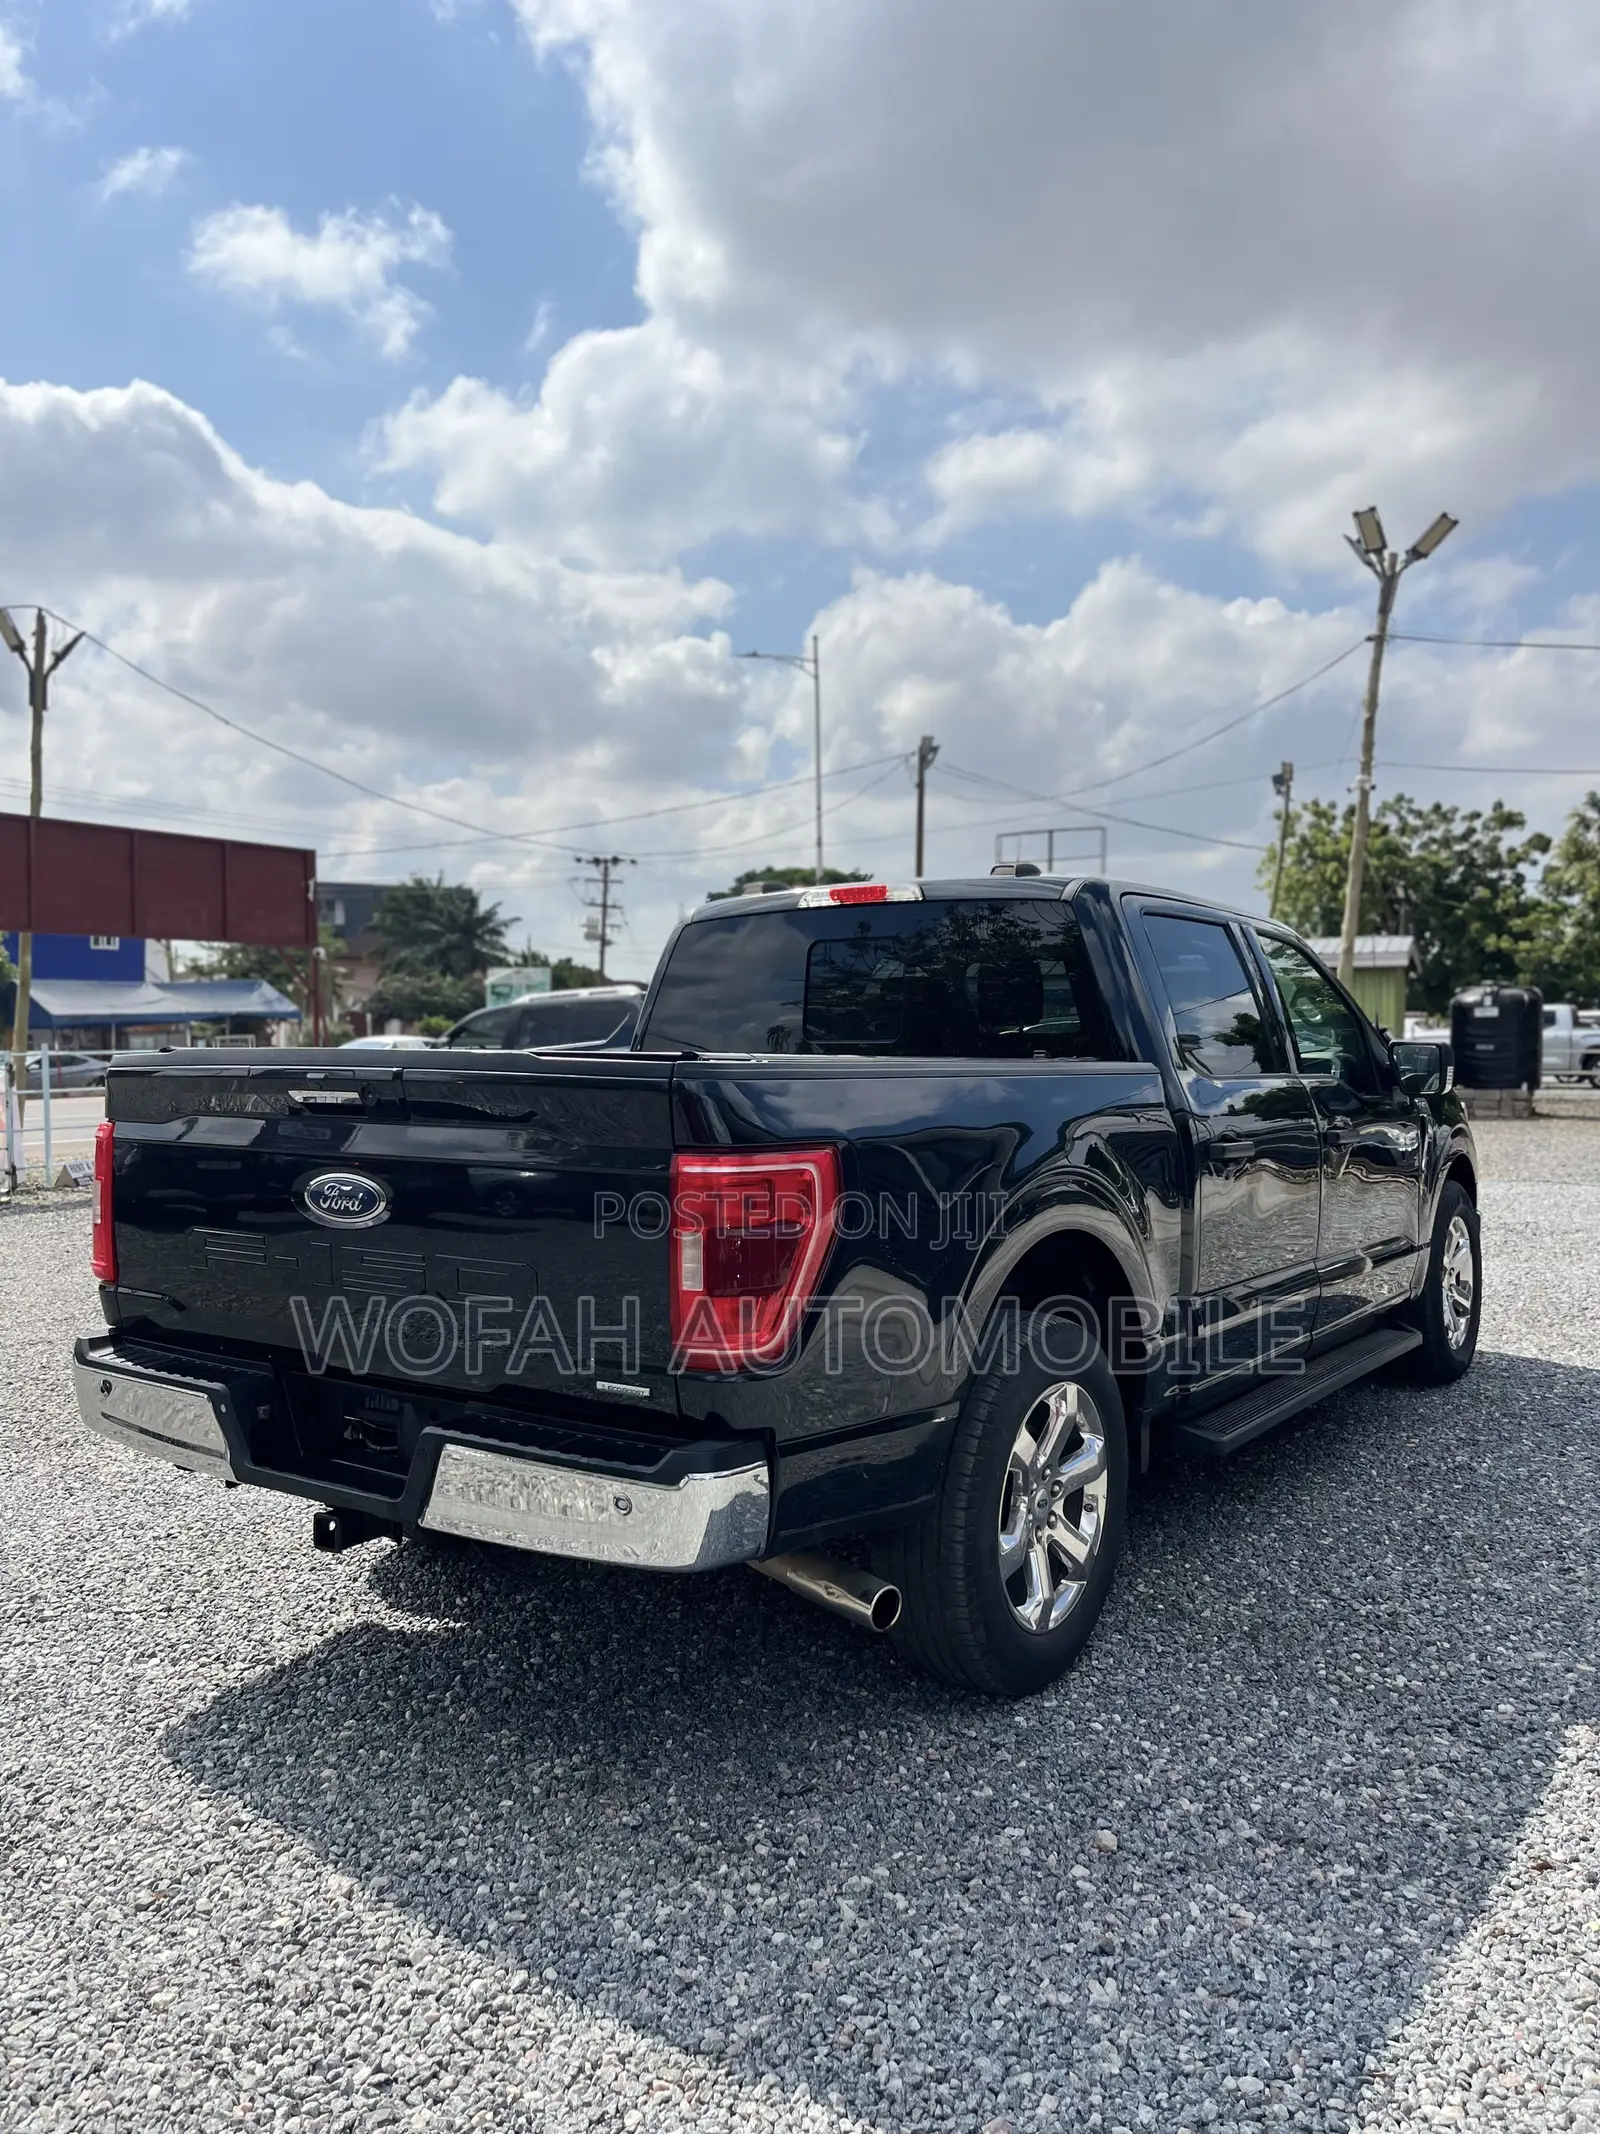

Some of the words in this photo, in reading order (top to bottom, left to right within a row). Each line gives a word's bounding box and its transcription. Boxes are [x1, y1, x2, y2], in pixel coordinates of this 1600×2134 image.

[320, 1183, 364, 1211] Ford
[188, 1226, 540, 1313] F-150
[607, 1385, 645, 1397] ECOBOOST
